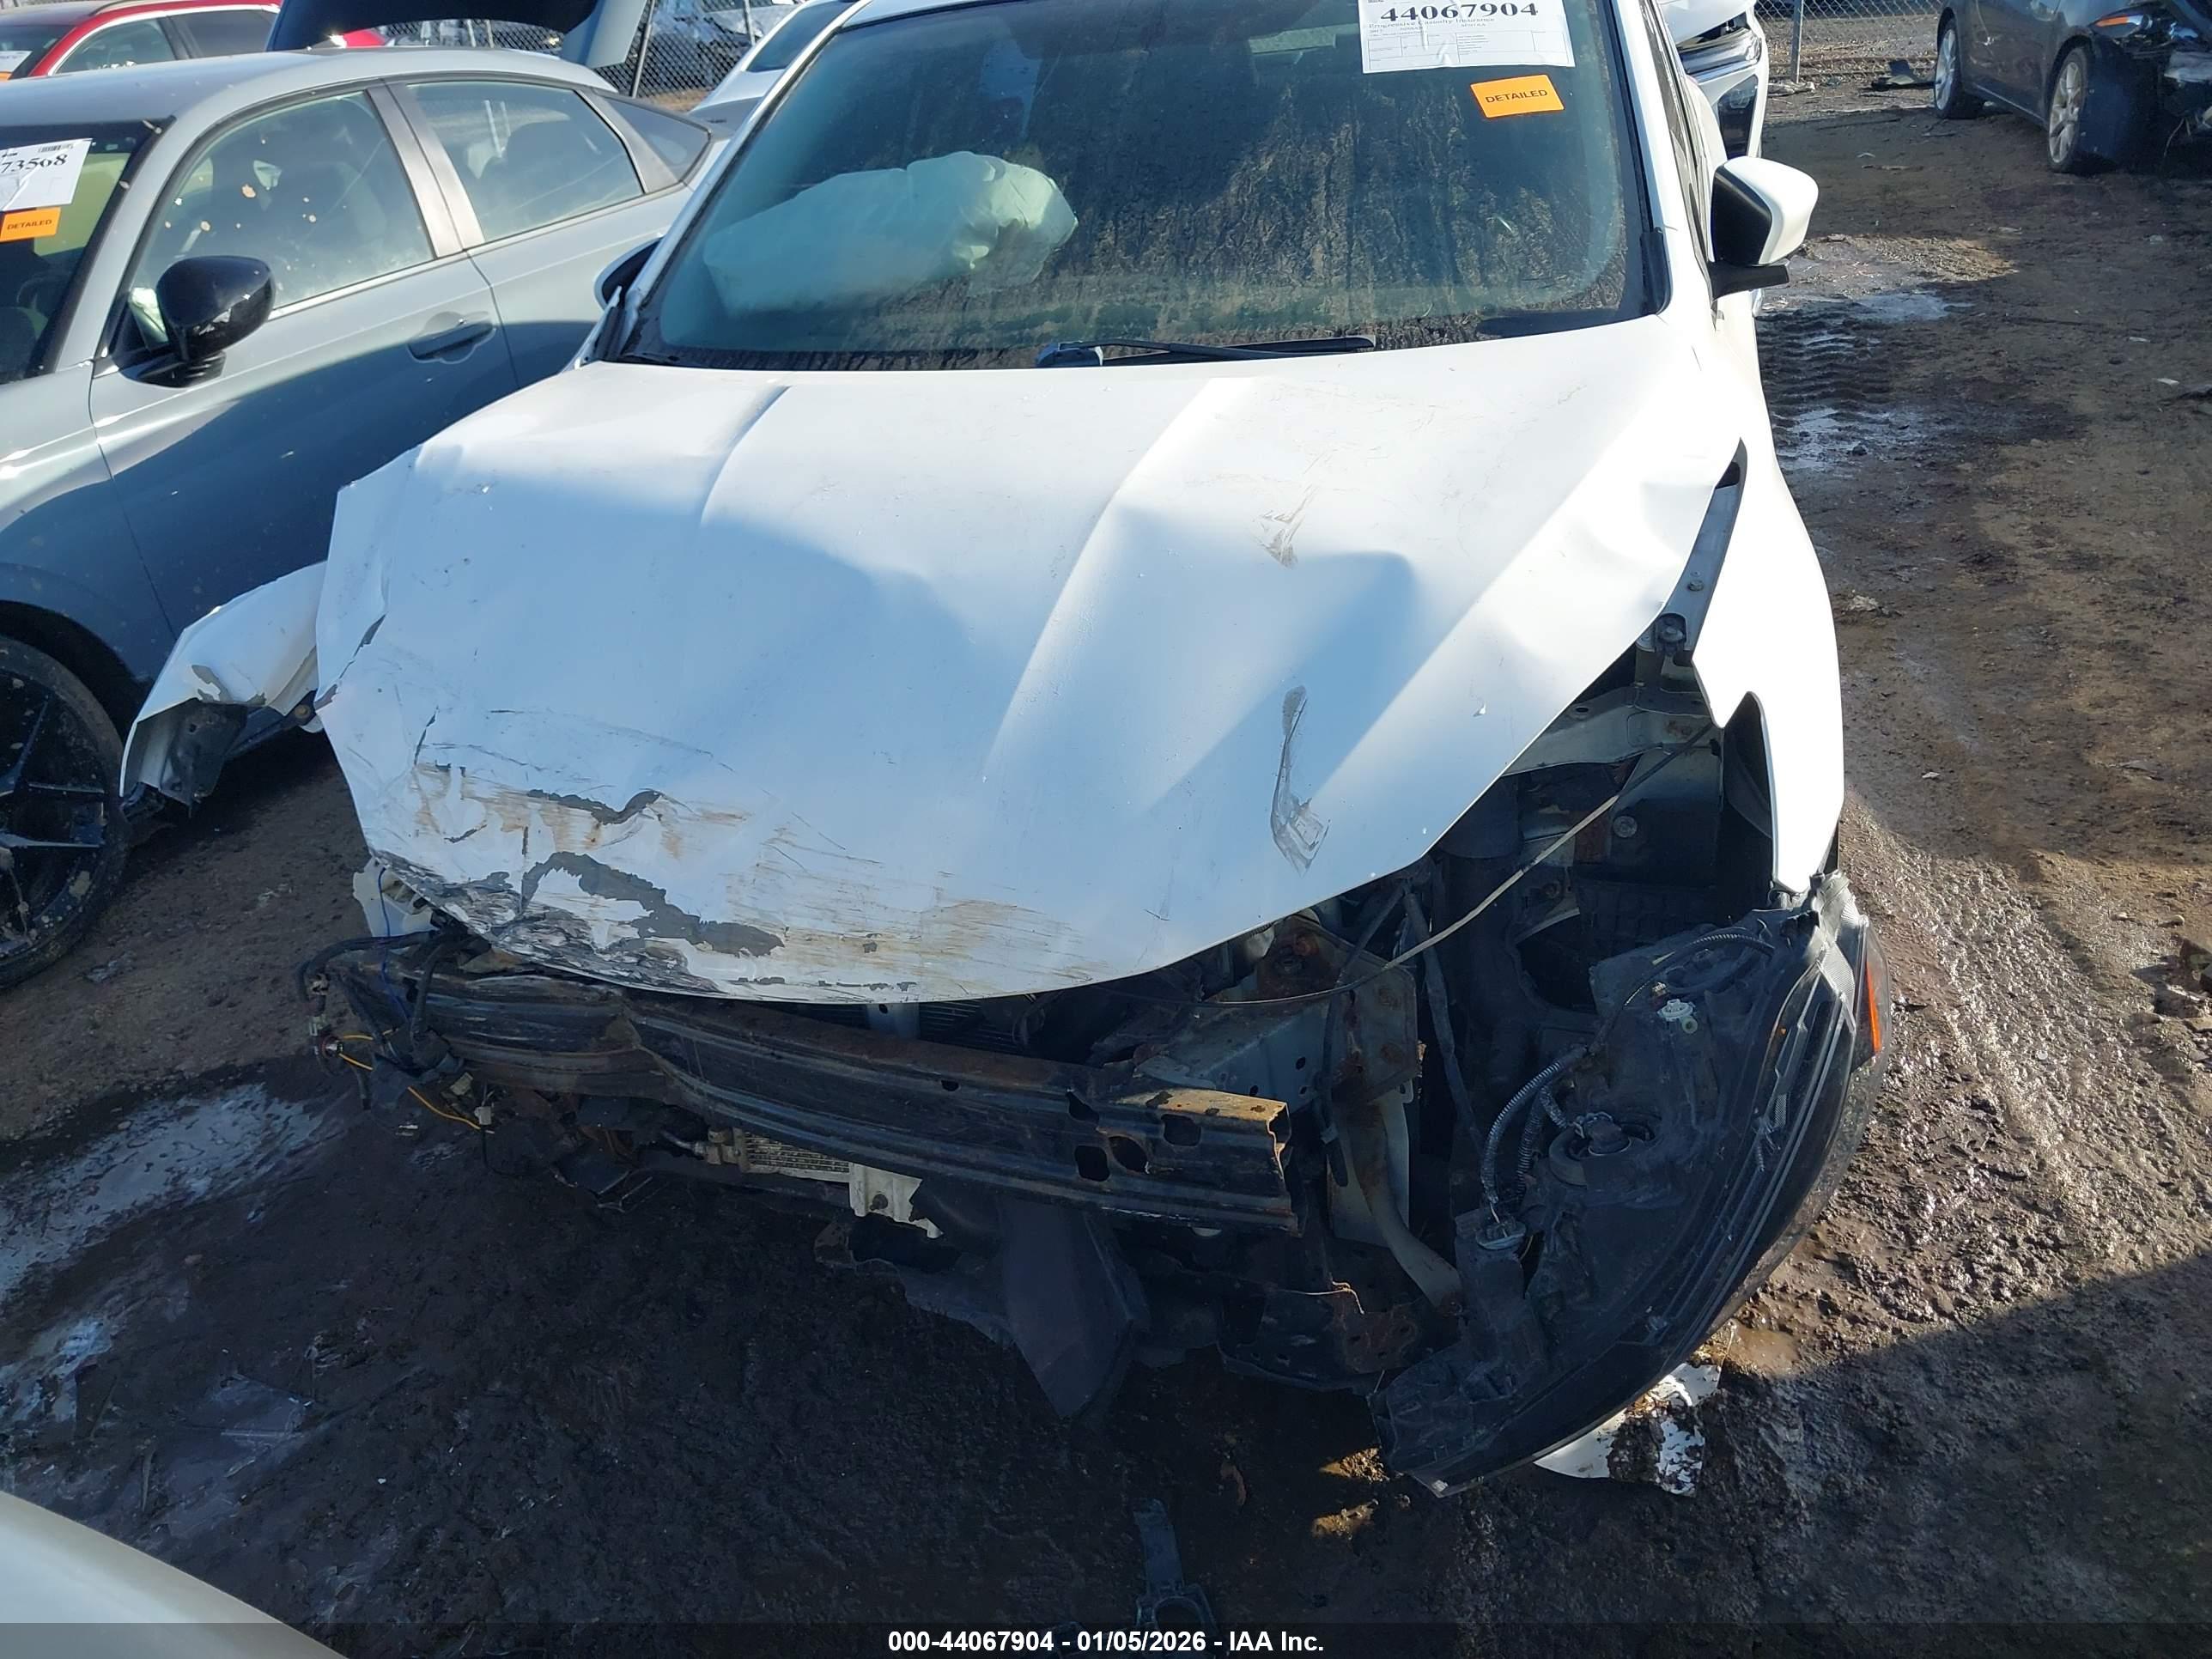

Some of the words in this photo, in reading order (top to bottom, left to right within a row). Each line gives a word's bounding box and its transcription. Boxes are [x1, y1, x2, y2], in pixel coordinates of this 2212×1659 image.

[1381, 3, 1538, 21] 44067904
[1485, 88, 1547, 103] DETAILED
[7, 219, 52, 230] DETAILED
